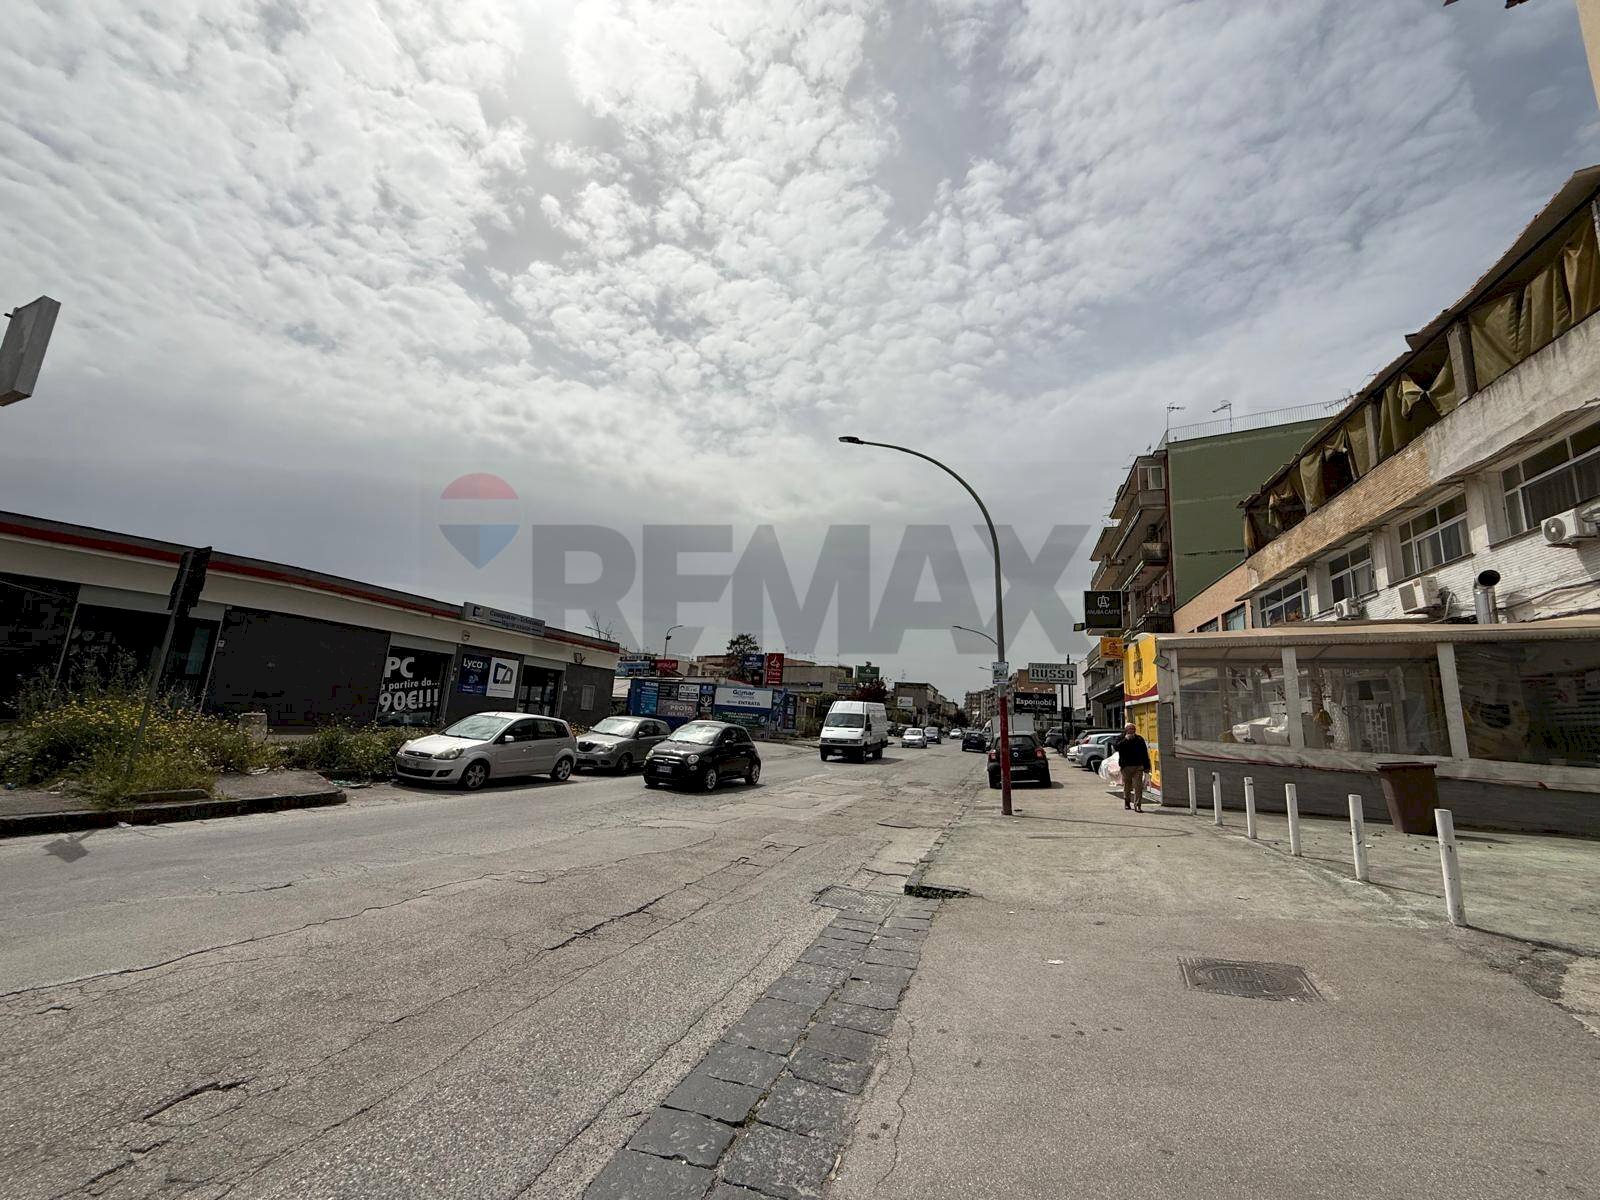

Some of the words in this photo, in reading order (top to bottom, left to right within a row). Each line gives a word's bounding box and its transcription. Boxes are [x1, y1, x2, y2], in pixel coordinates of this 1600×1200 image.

[384, 656, 415, 678] PC
[463, 657, 484, 669] Lyca
[1031, 669, 1074, 679] RUSSO
[388, 679, 419, 692] partire
[421, 676, 440, 687] da...
[379, 688, 439, 712] 90€!!!
